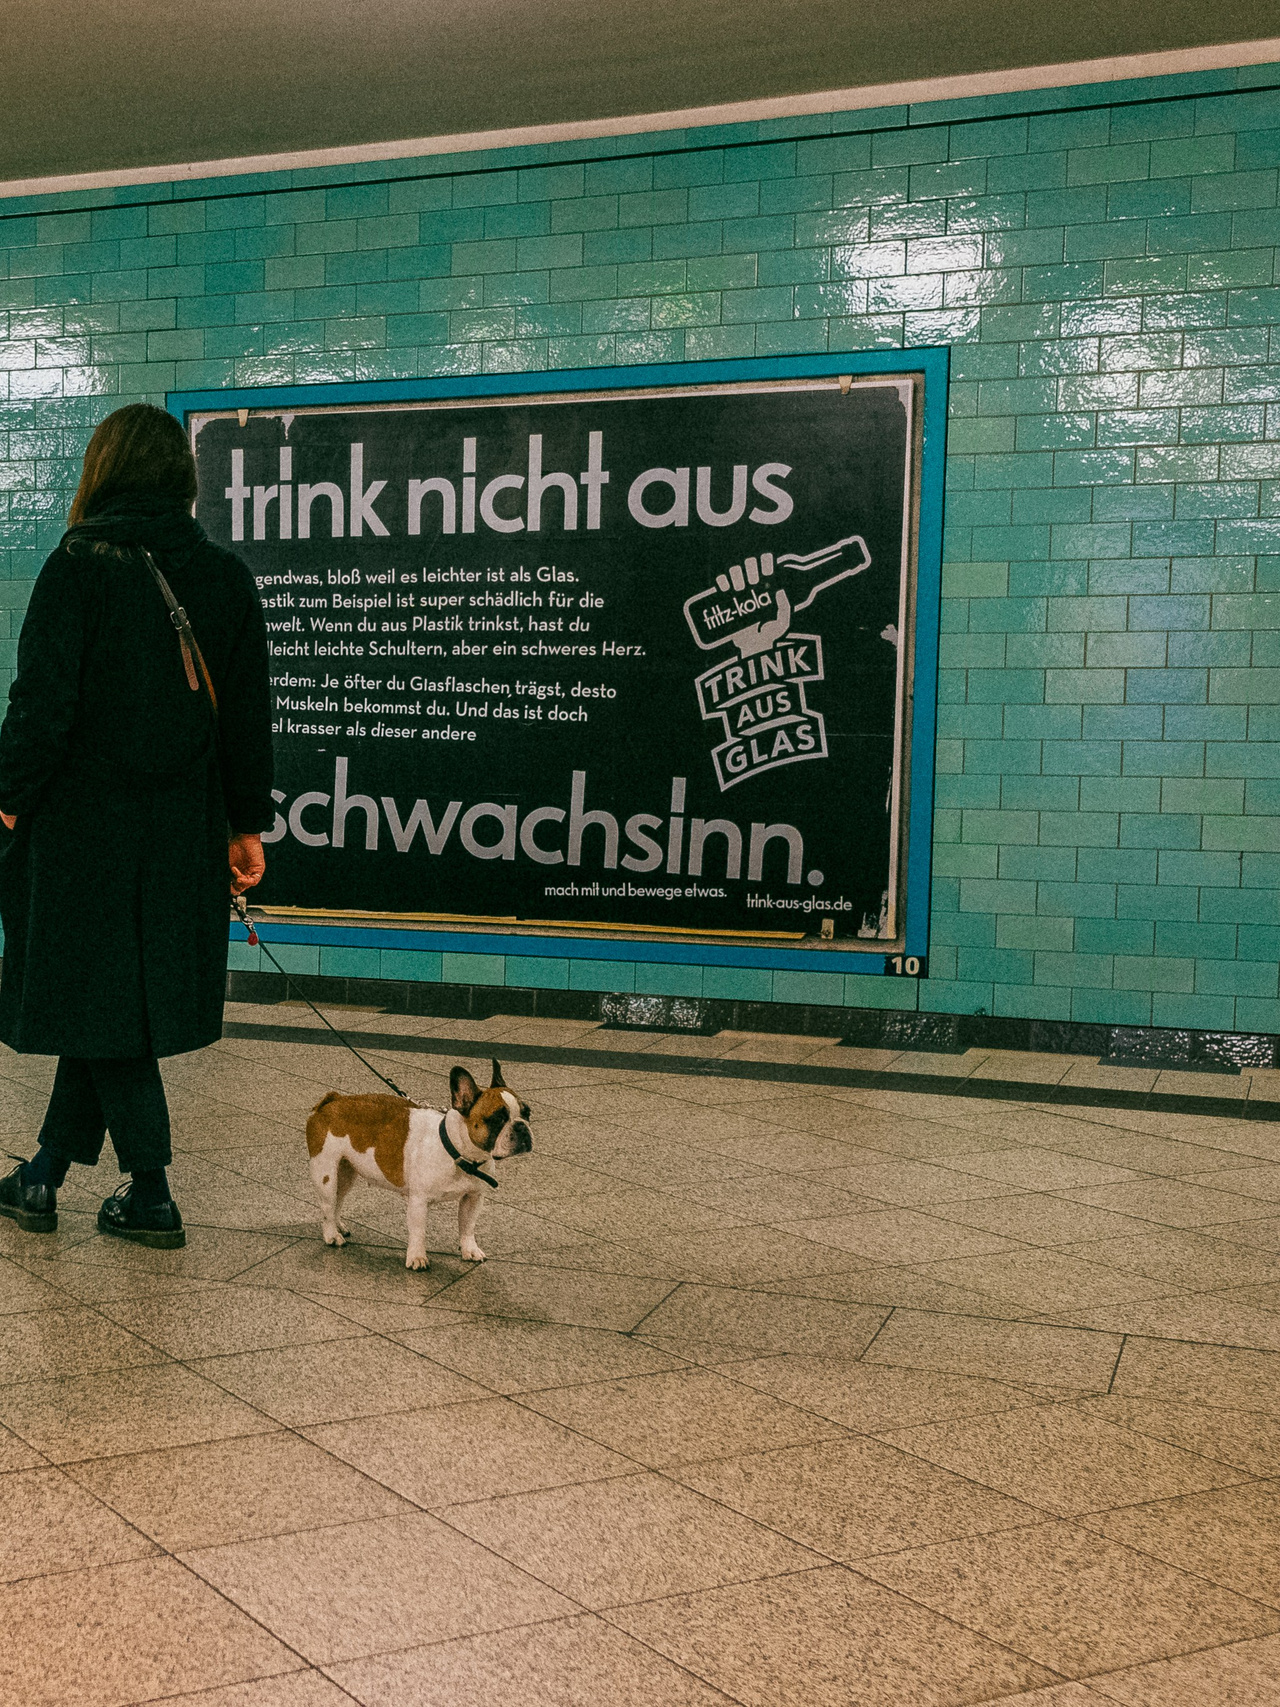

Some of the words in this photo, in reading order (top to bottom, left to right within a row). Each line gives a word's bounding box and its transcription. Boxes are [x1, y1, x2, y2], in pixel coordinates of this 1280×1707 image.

[225, 443, 390, 541] trink
[408, 431, 609, 535] nicht
[628, 463, 793, 528] aus
[255, 570, 322, 589] gendwas,
[328, 569, 360, 584] bloß
[366, 568, 395, 584] weil
[401, 574, 417, 583] es
[423, 567, 482, 582] leichter
[487, 568, 504, 582] ist
[510, 566, 531, 582] als
[537, 566, 579, 582] Glas.
[262, 592, 294, 608] astik
[299, 598, 327, 608] zum
[333, 592, 391, 612] Beispiel
[397, 594, 414, 607] ist
[420, 596, 464, 610] super
[470, 591, 542, 606] schädlich
[549, 591, 574, 607] für
[579, 591, 604, 607] die
[703, 590, 772, 630] fritz-kola
[310, 617, 352, 632] Wenn
[358, 617, 376, 631] du
[382, 622, 407, 631] aus
[413, 615, 463, 631] Plastik
[469, 615, 523, 632] trinkst,
[529, 616, 563, 631] hast
[569, 616, 589, 631] du
[315, 641, 363, 655] leichte
[369, 640, 446, 657] Schultern,
[452, 640, 488, 655] aber
[493, 641, 516, 655] ein
[522, 640, 596, 655] schweres
[603, 641, 645, 655] Herz.
[704, 646, 811, 703] TRINK
[321, 674, 339, 688] Je
[344, 674, 382, 689] öfter
[387, 675, 404, 690] du
[410, 676, 511, 695] Glasflaschen
[515, 681, 565, 699] trägst,
[571, 681, 616, 698] desto
[277, 696, 338, 711] Muskeln
[344, 697, 421, 714] bekommst
[427, 700, 449, 715] du.
[456, 702, 487, 717] Und
[493, 703, 519, 718] das
[525, 705, 542, 719] ist
[548, 705, 587, 721] doch
[736, 691, 791, 728] AUS
[272, 718, 282, 732] el
[288, 718, 341, 735] krasser
[346, 721, 366, 736] als
[371, 722, 417, 738] dieser
[422, 725, 476, 740] andere
[725, 724, 815, 773] GLAS
[545, 882, 578, 895] mach
[582, 882, 599, 896] mit
[602, 883, 625, 896] und
[628, 883, 682, 900] bewege
[685, 883, 727, 897] etwas.
[747, 894, 852, 912] trink-aus-glas.de
[892, 957, 919, 974] 10
